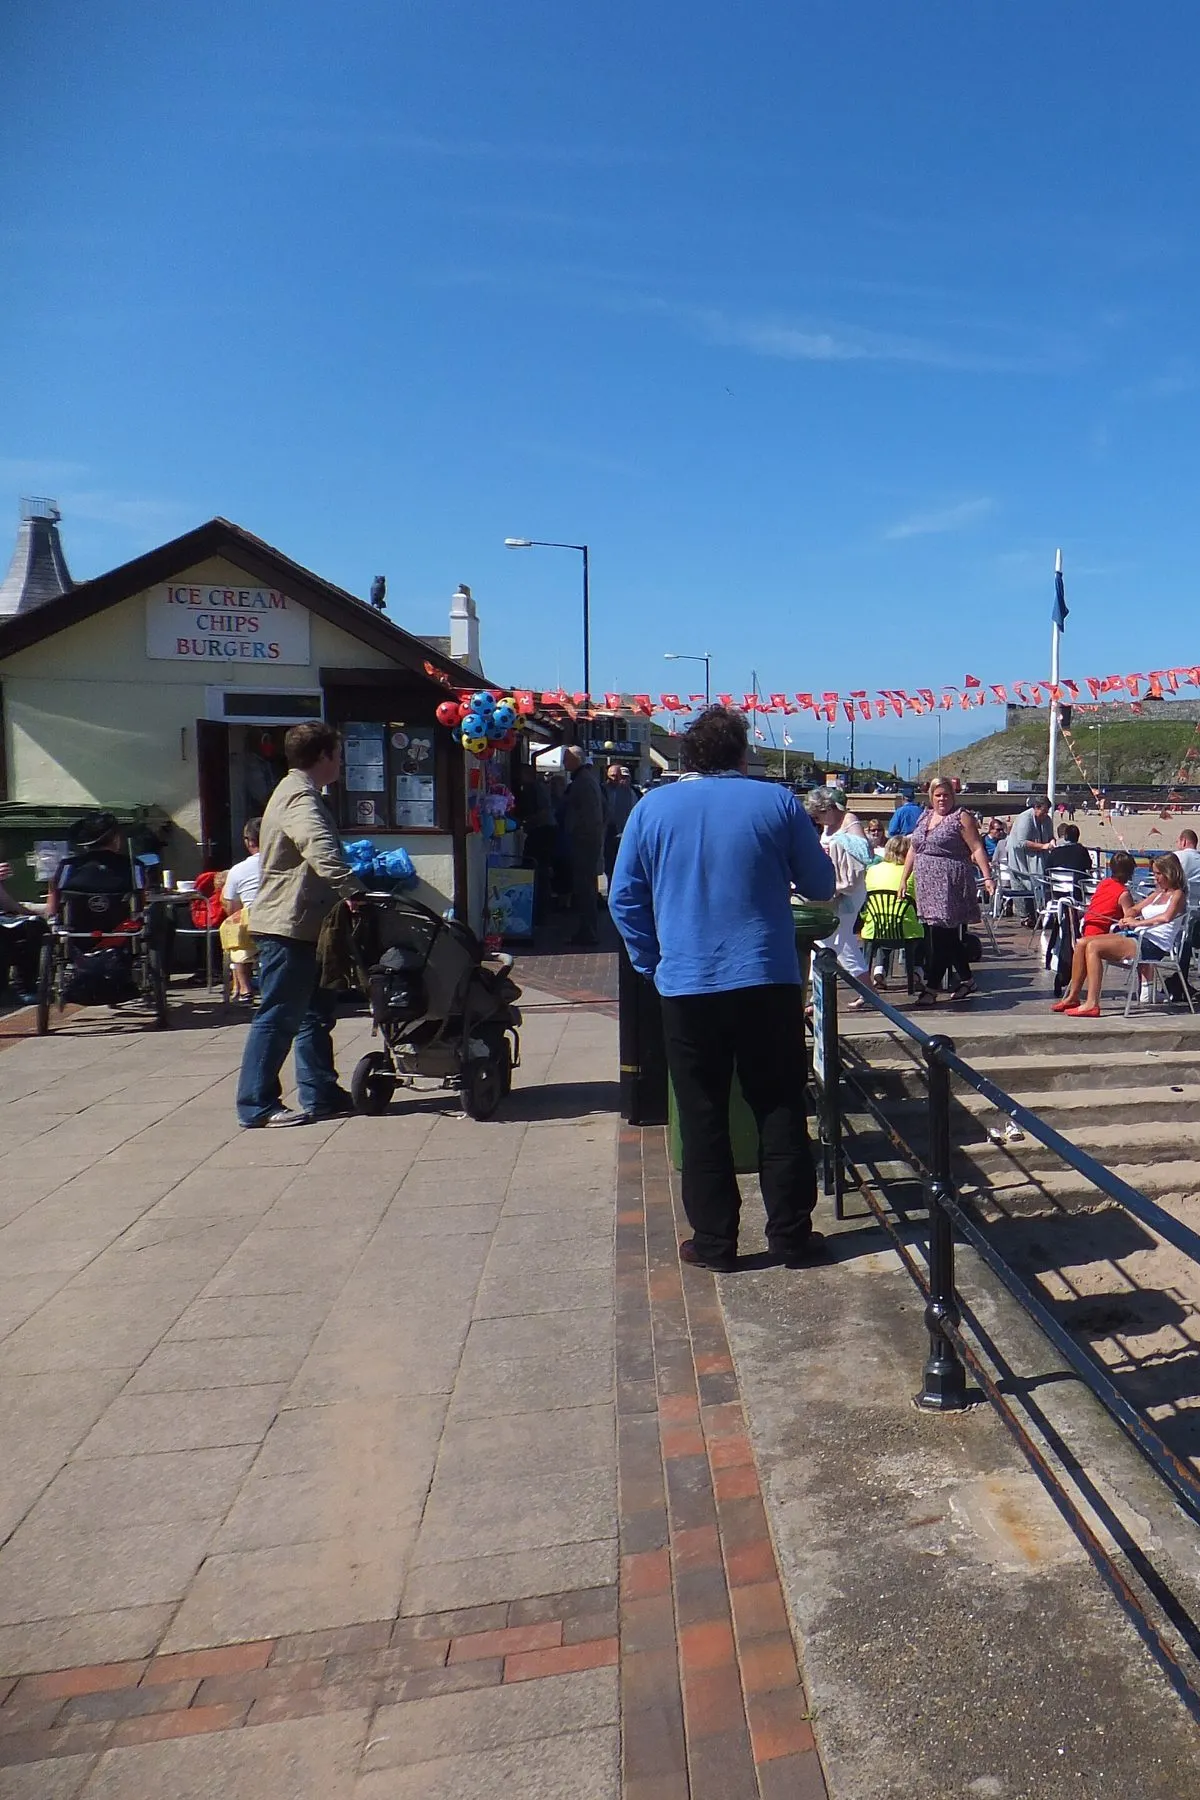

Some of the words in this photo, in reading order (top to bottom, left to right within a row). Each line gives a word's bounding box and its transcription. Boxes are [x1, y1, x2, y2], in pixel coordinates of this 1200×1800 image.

[167, 588, 202, 605] ICE
[209, 590, 287, 609] CREAM
[197, 615, 259, 632] CHIPS
[177, 638, 280, 659] BURGERS
